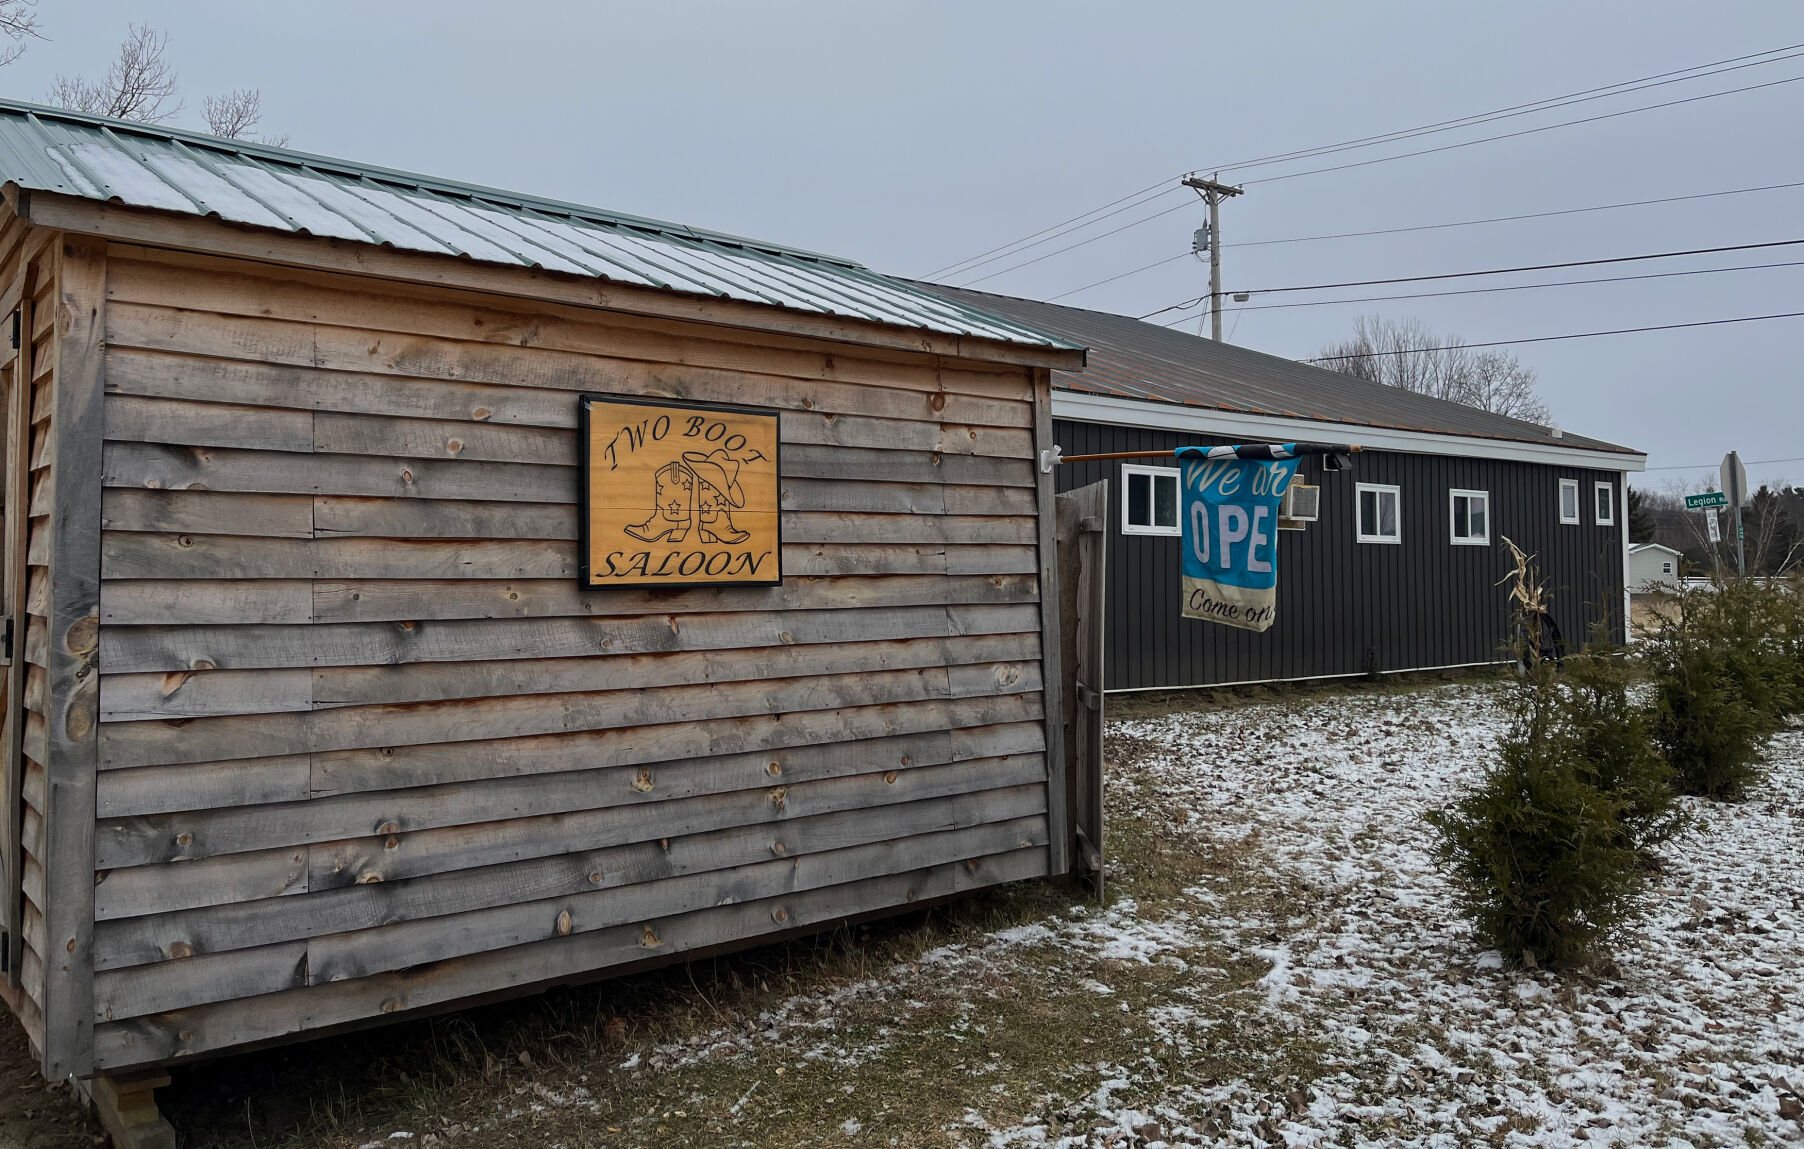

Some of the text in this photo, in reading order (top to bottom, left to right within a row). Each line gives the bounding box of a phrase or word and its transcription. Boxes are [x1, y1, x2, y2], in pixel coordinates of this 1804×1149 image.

[604, 415, 771, 471] TWO BOOT
[1187, 459, 1289, 497] We ar
[1688, 497, 1717, 507] Legion
[1190, 501, 1272, 573] OPE
[595, 551, 772, 578] SALOON
[1189, 588, 1273, 623] Come on
